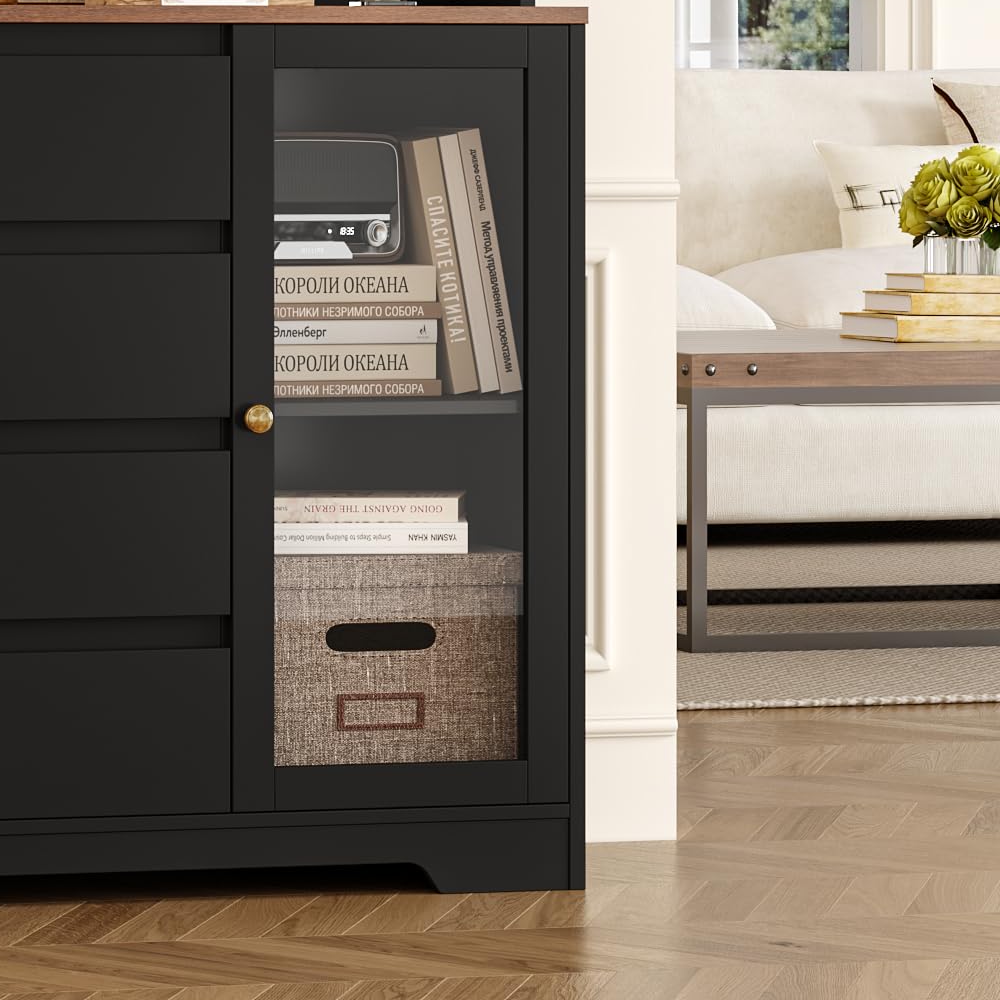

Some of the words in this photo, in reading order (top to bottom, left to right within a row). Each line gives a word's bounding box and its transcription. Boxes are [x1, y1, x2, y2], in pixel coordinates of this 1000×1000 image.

[427, 195, 453, 269] СПАСИТЕ
[440, 271, 466, 343] КОТИКА!
[274, 277, 339, 294] КОРОЛИ
[344, 276, 409, 293] ОКЕАНА
[481, 221, 493, 253] Метод
[495, 318, 513, 373] проектами
[322, 306, 382, 318] НЕЗРИМОГО
[385, 306, 425, 317] СОБОРА
[273, 325, 327, 340] Элленберг
[274, 355, 339, 372] КОРОЛИ
[344, 354, 409, 371] ОКЕАНА
[322, 384, 382, 395] НЕЗРИМОГО
[385, 383, 425, 395] СОБОРА
[303, 505, 336, 513] GRAIN
[339, 505, 359, 513] THE
[362, 504, 407, 513] AGAINST
[410, 504, 443, 513] GOING
